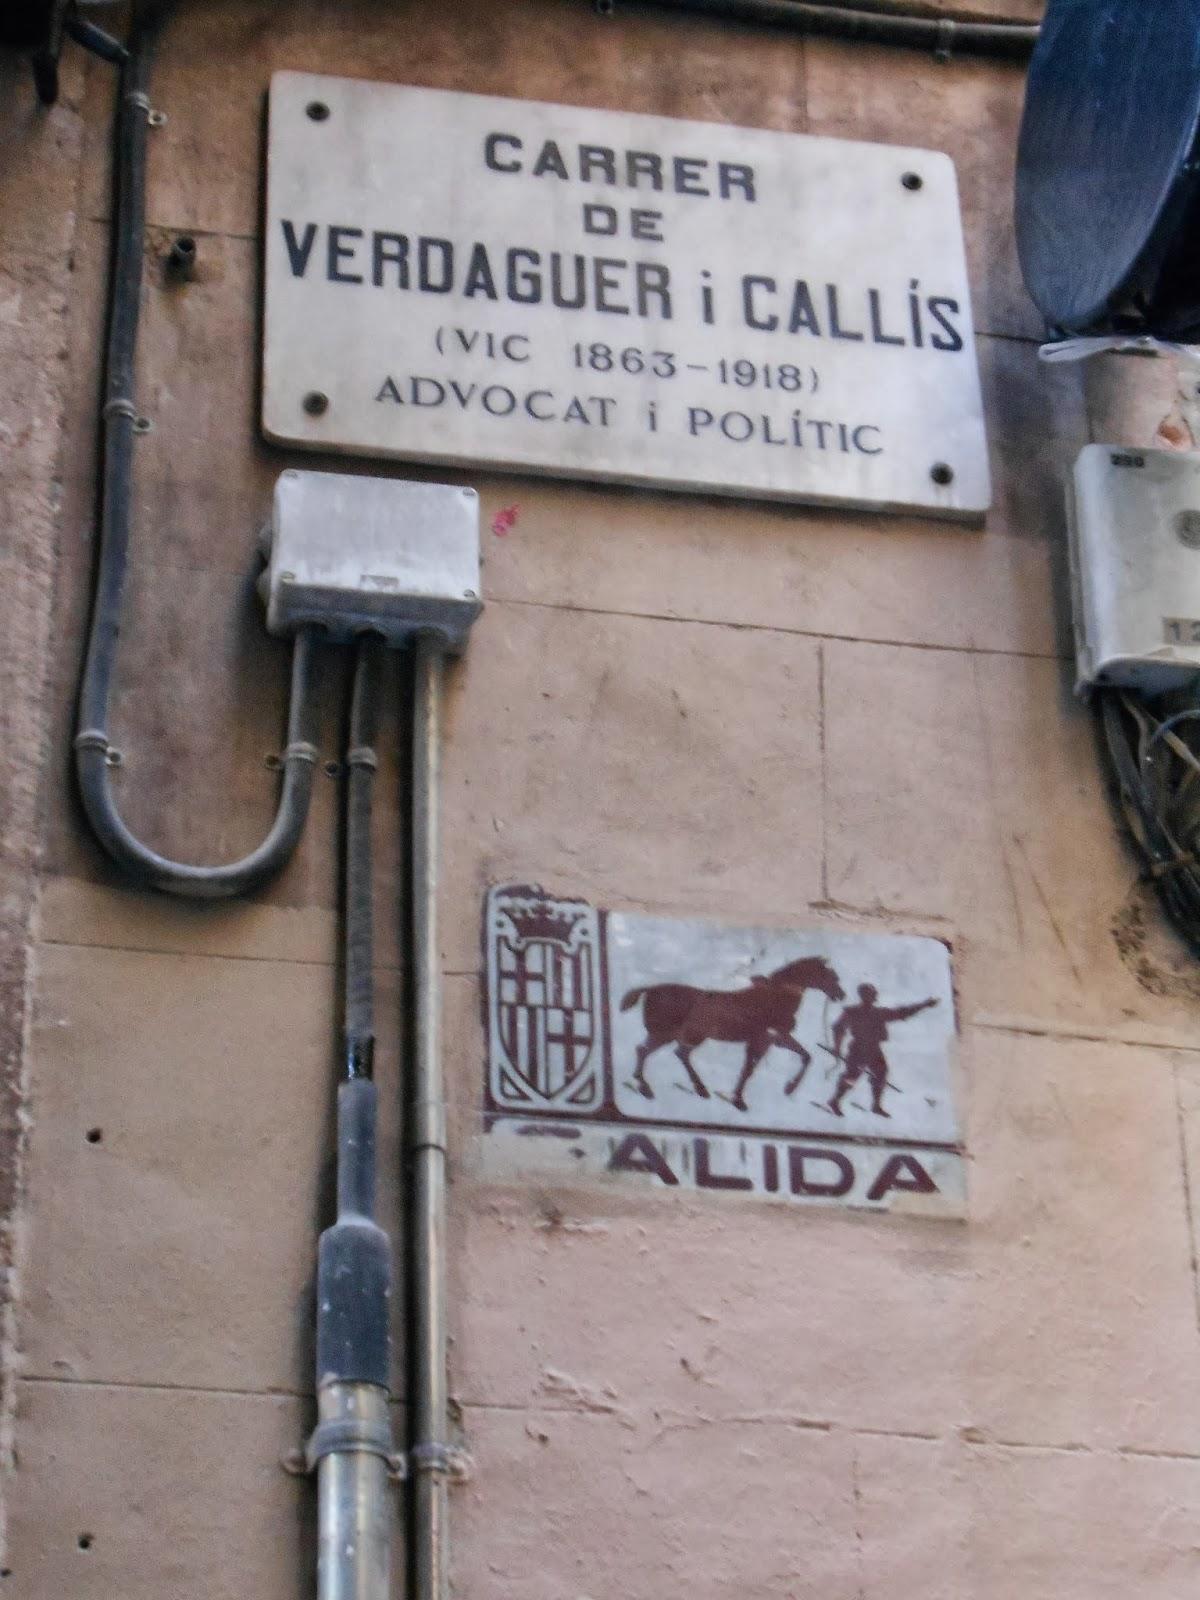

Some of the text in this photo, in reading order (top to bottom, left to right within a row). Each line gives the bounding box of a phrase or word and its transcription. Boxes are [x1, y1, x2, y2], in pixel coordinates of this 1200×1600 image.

[485, 133, 755, 202] CARRER
[583, 203, 663, 241] DE
[281, 220, 964, 351] VERDAGUER i CALLÍS
[435, 327, 820, 393] (VIC 1863-1918)
[376, 376, 883, 455] ADVOCAT i POLÍTIC
